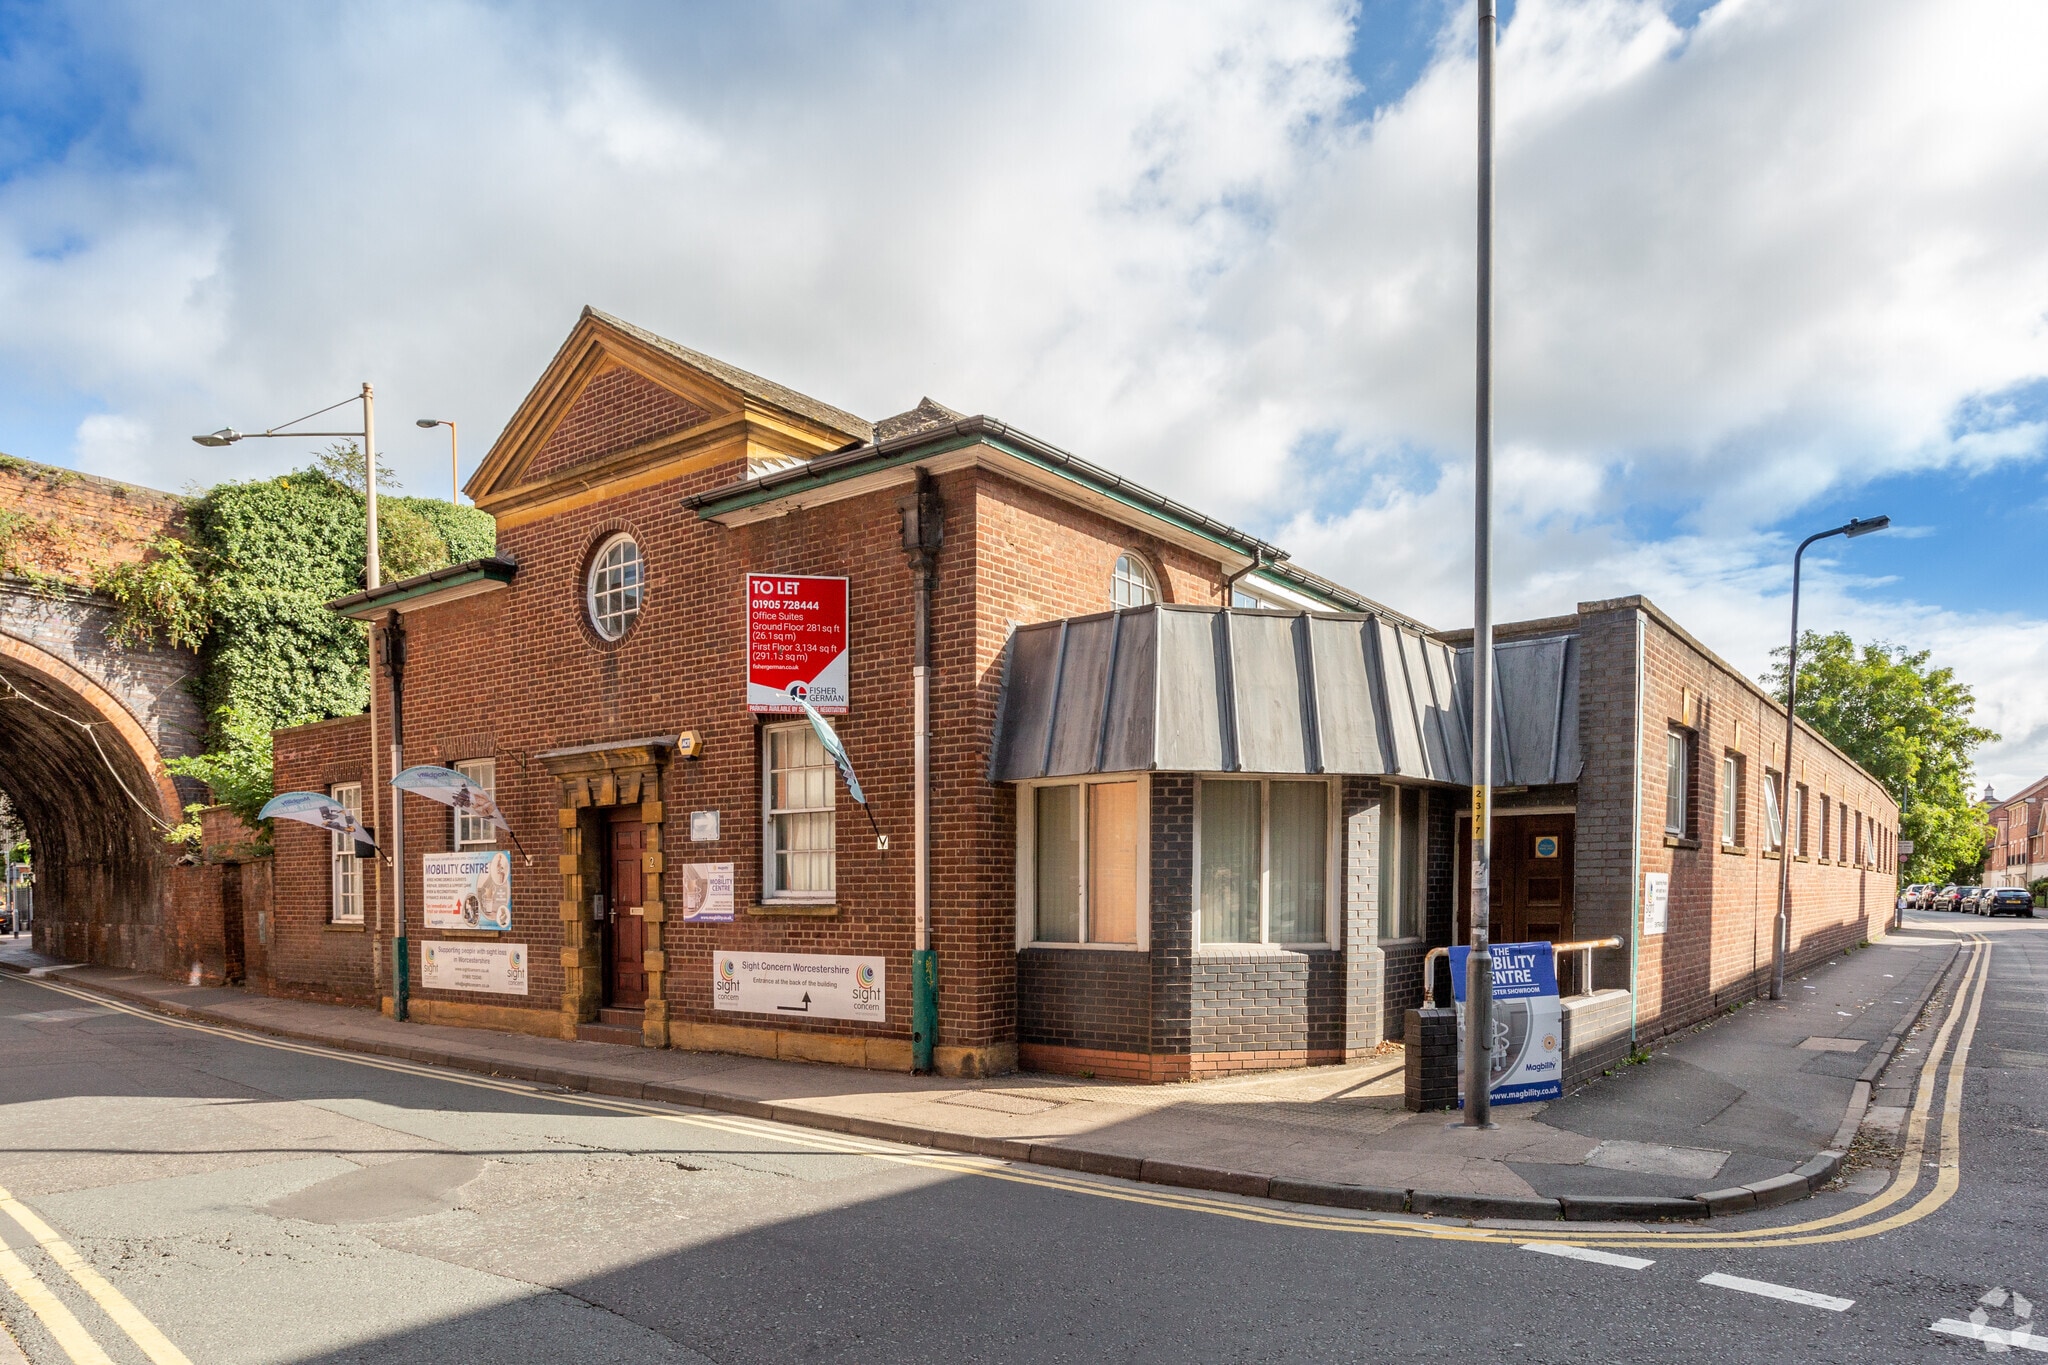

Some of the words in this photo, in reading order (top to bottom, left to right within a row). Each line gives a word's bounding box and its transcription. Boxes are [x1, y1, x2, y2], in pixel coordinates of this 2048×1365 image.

[752, 581, 774, 594] TO
[777, 581, 800, 595] LET
[752, 600, 780, 609] 01905
[782, 600, 820, 610] 728444
[752, 611, 777, 620] Office
[778, 612, 804, 620] Suites
[752, 622, 782, 631] Ground
[784, 622, 804, 631] Floor
[806, 623, 821, 632] 281
[822, 625, 832, 634] sq
[834, 624, 840, 633] ft
[752, 631, 772, 641] (26.1
[773, 633, 784, 642] sq
[785, 632, 796, 642] m)
[752, 642, 771, 651] First
[772, 643, 793, 651] Floor
[794, 643, 817, 652] 3,134
[819, 645, 829, 654] sq
[831, 644, 837, 653] ft
[785, 654, 796, 662] sq
[796, 653, 808, 663] m)
[752, 663, 799, 671] fishergerman.co.uk
[809, 686, 837, 694] FISHER
[809, 694, 844, 702] GERMAN
[649, 856, 656, 868] 2
[425, 863, 459, 875] MOBILITY
[459, 862, 489, 874] CENTRE
[438, 946, 460, 955] Supporting
[486, 948, 497, 956] sight
[1493, 947, 1510, 956] THE
[458, 957, 490, 965] Worcestershire
[1491, 955, 1536, 970] BILITY
[424, 963, 438, 975] sight
[507, 968, 525, 980] sight
[742, 961, 760, 971] Sight
[761, 961, 792, 971] Concern
[793, 963, 850, 975] Worcestershire
[716, 978, 740, 994] sight
[752, 977, 774, 985] Entrance
[817, 980, 838, 989] building
[852, 986, 881, 1003] sight
[1507, 986, 1540, 995] SHOWROOM
[853, 1003, 880, 1011] concern
[1525, 1061, 1556, 1073] Magbility
